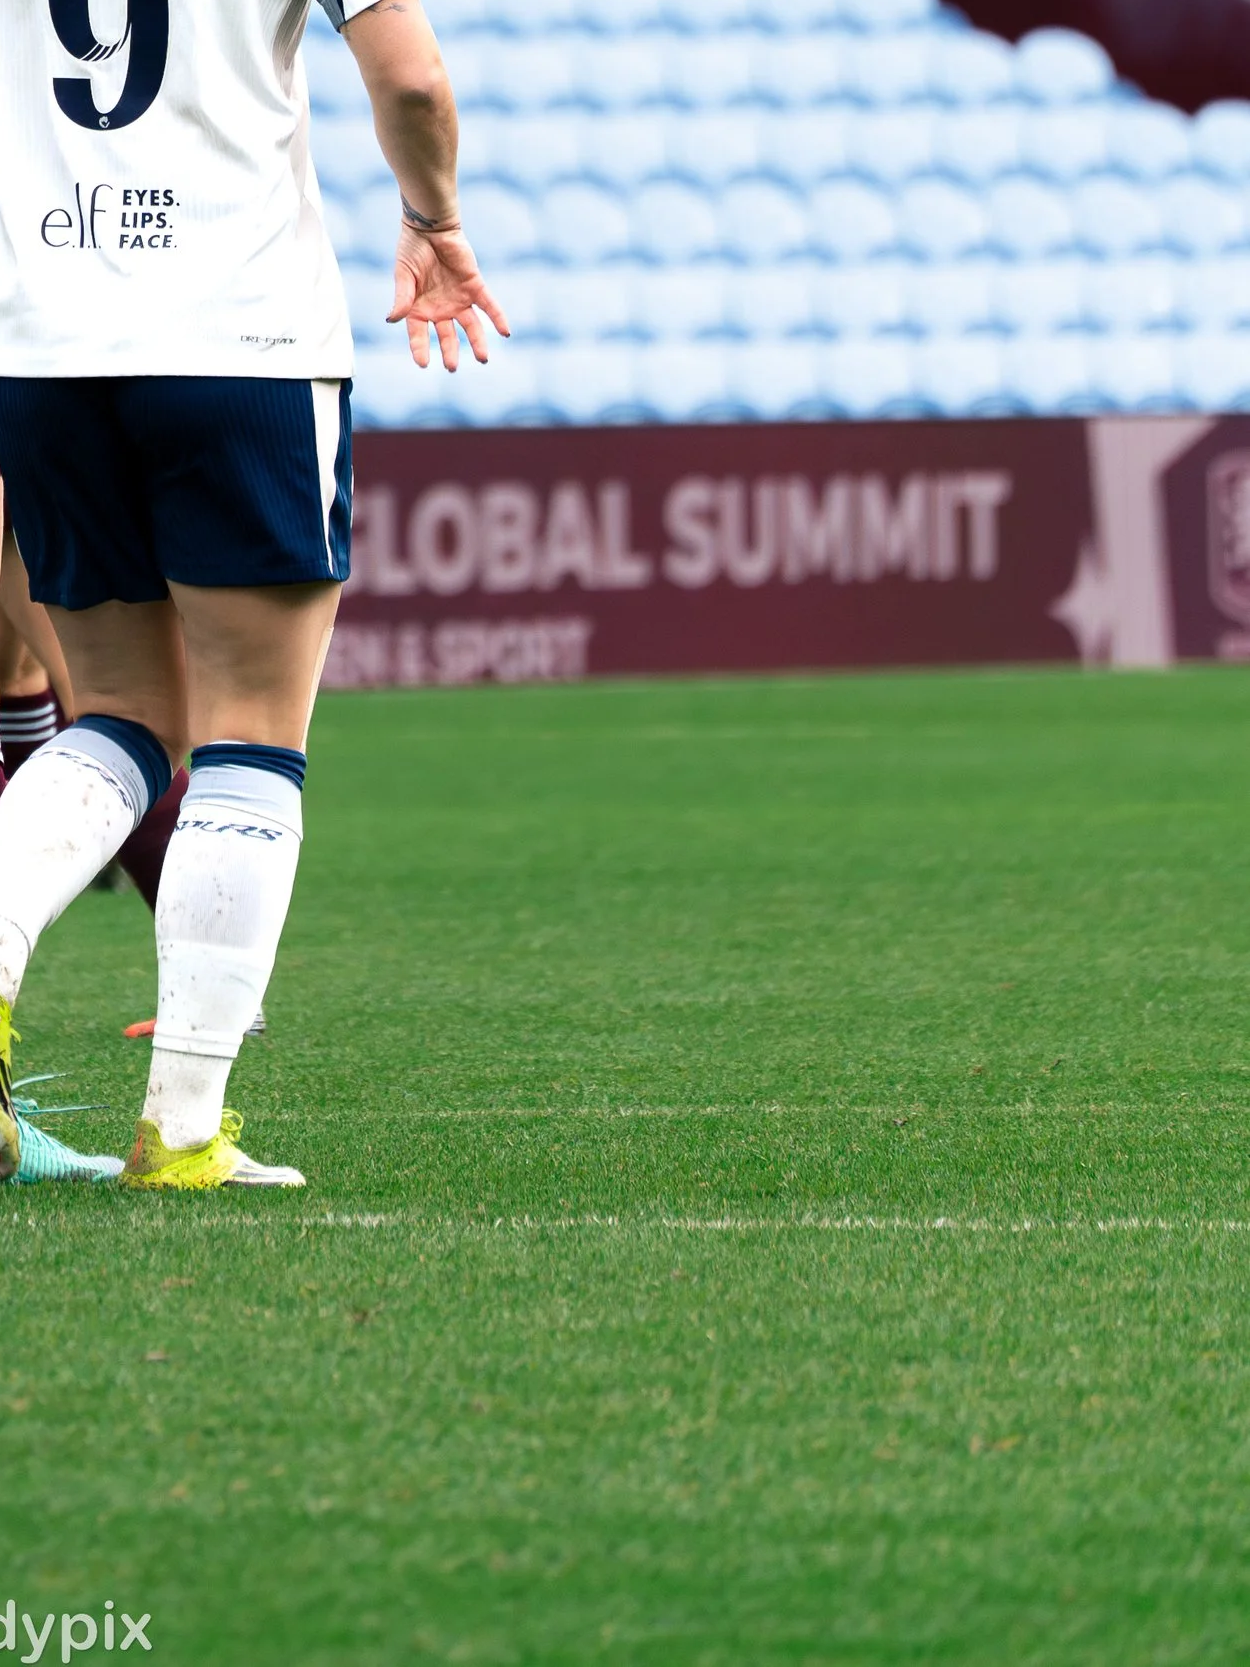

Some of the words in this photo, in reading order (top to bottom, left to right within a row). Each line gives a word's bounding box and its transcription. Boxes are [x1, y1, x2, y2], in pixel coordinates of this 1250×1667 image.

[122, 189, 180, 207] EYES.
[121, 212, 173, 229] LIPS.
[118, 234, 178, 250] FACE.
[662, 470, 1013, 589] SUMMIT
